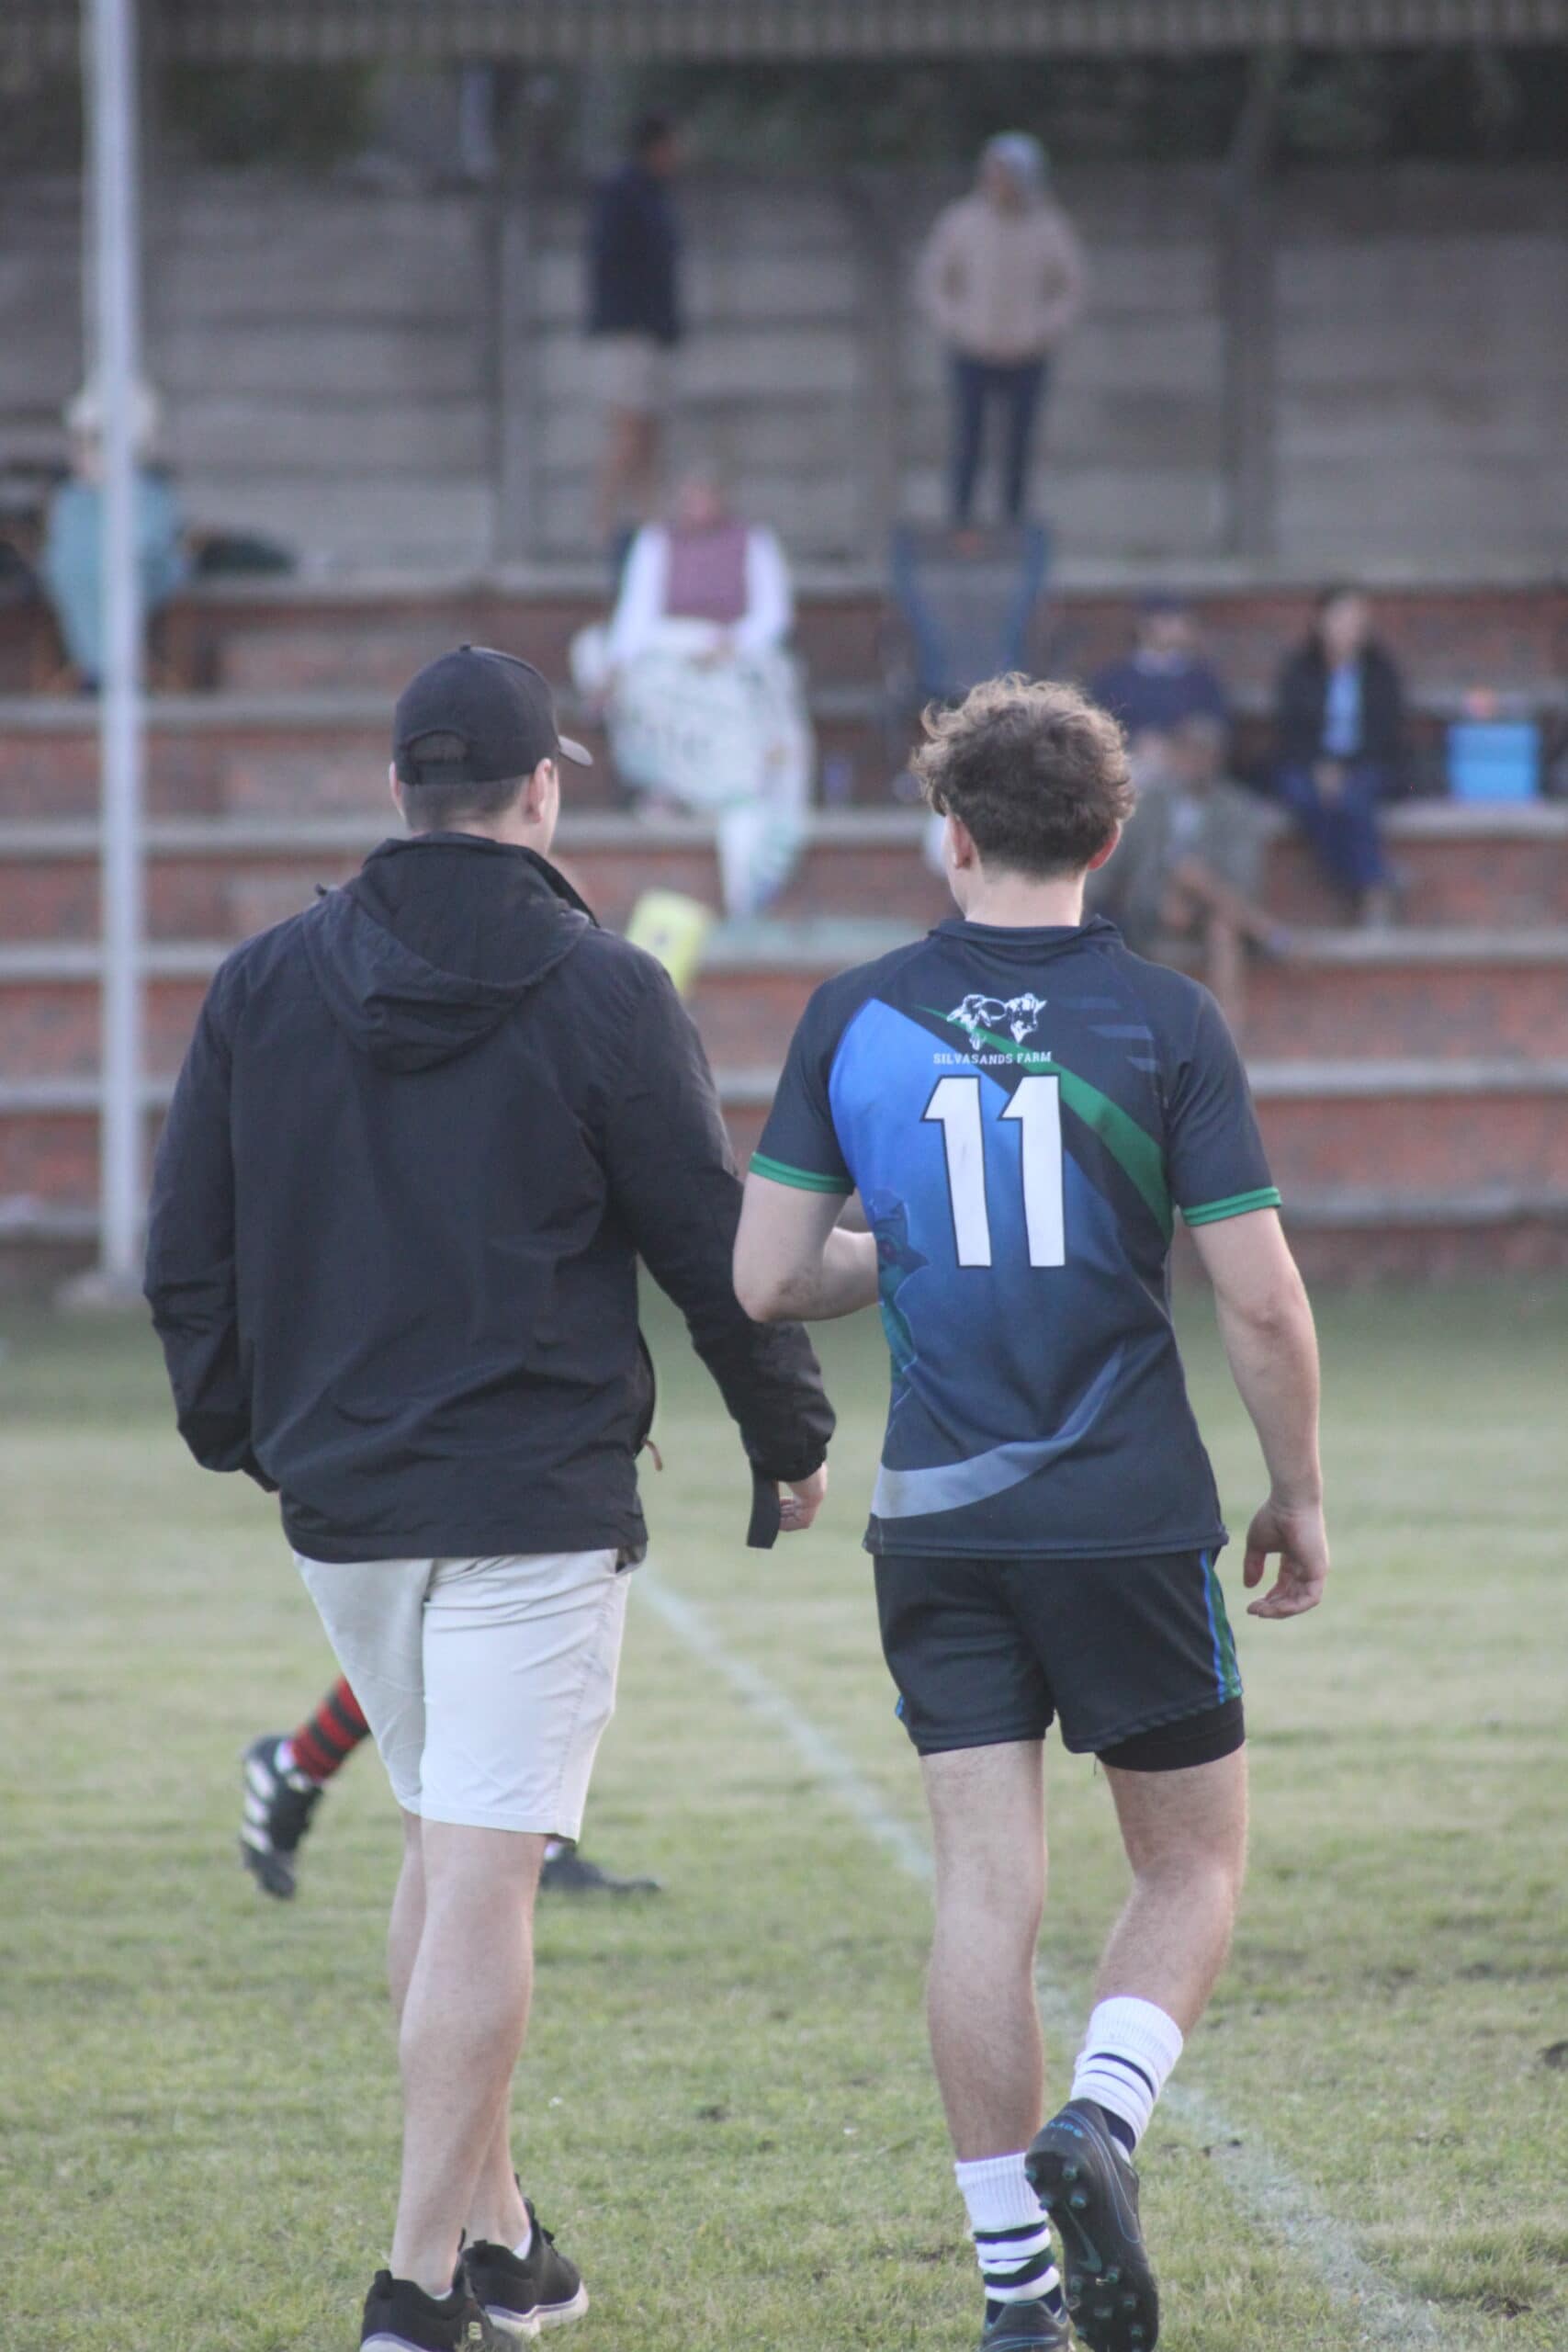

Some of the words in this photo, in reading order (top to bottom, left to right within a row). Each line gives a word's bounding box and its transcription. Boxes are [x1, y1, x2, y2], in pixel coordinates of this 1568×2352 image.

[932, 1052, 1013, 1066] SILVASANDS
[1016, 1050, 1053, 1064] FARM
[921, 1074, 1066, 1267] 11
